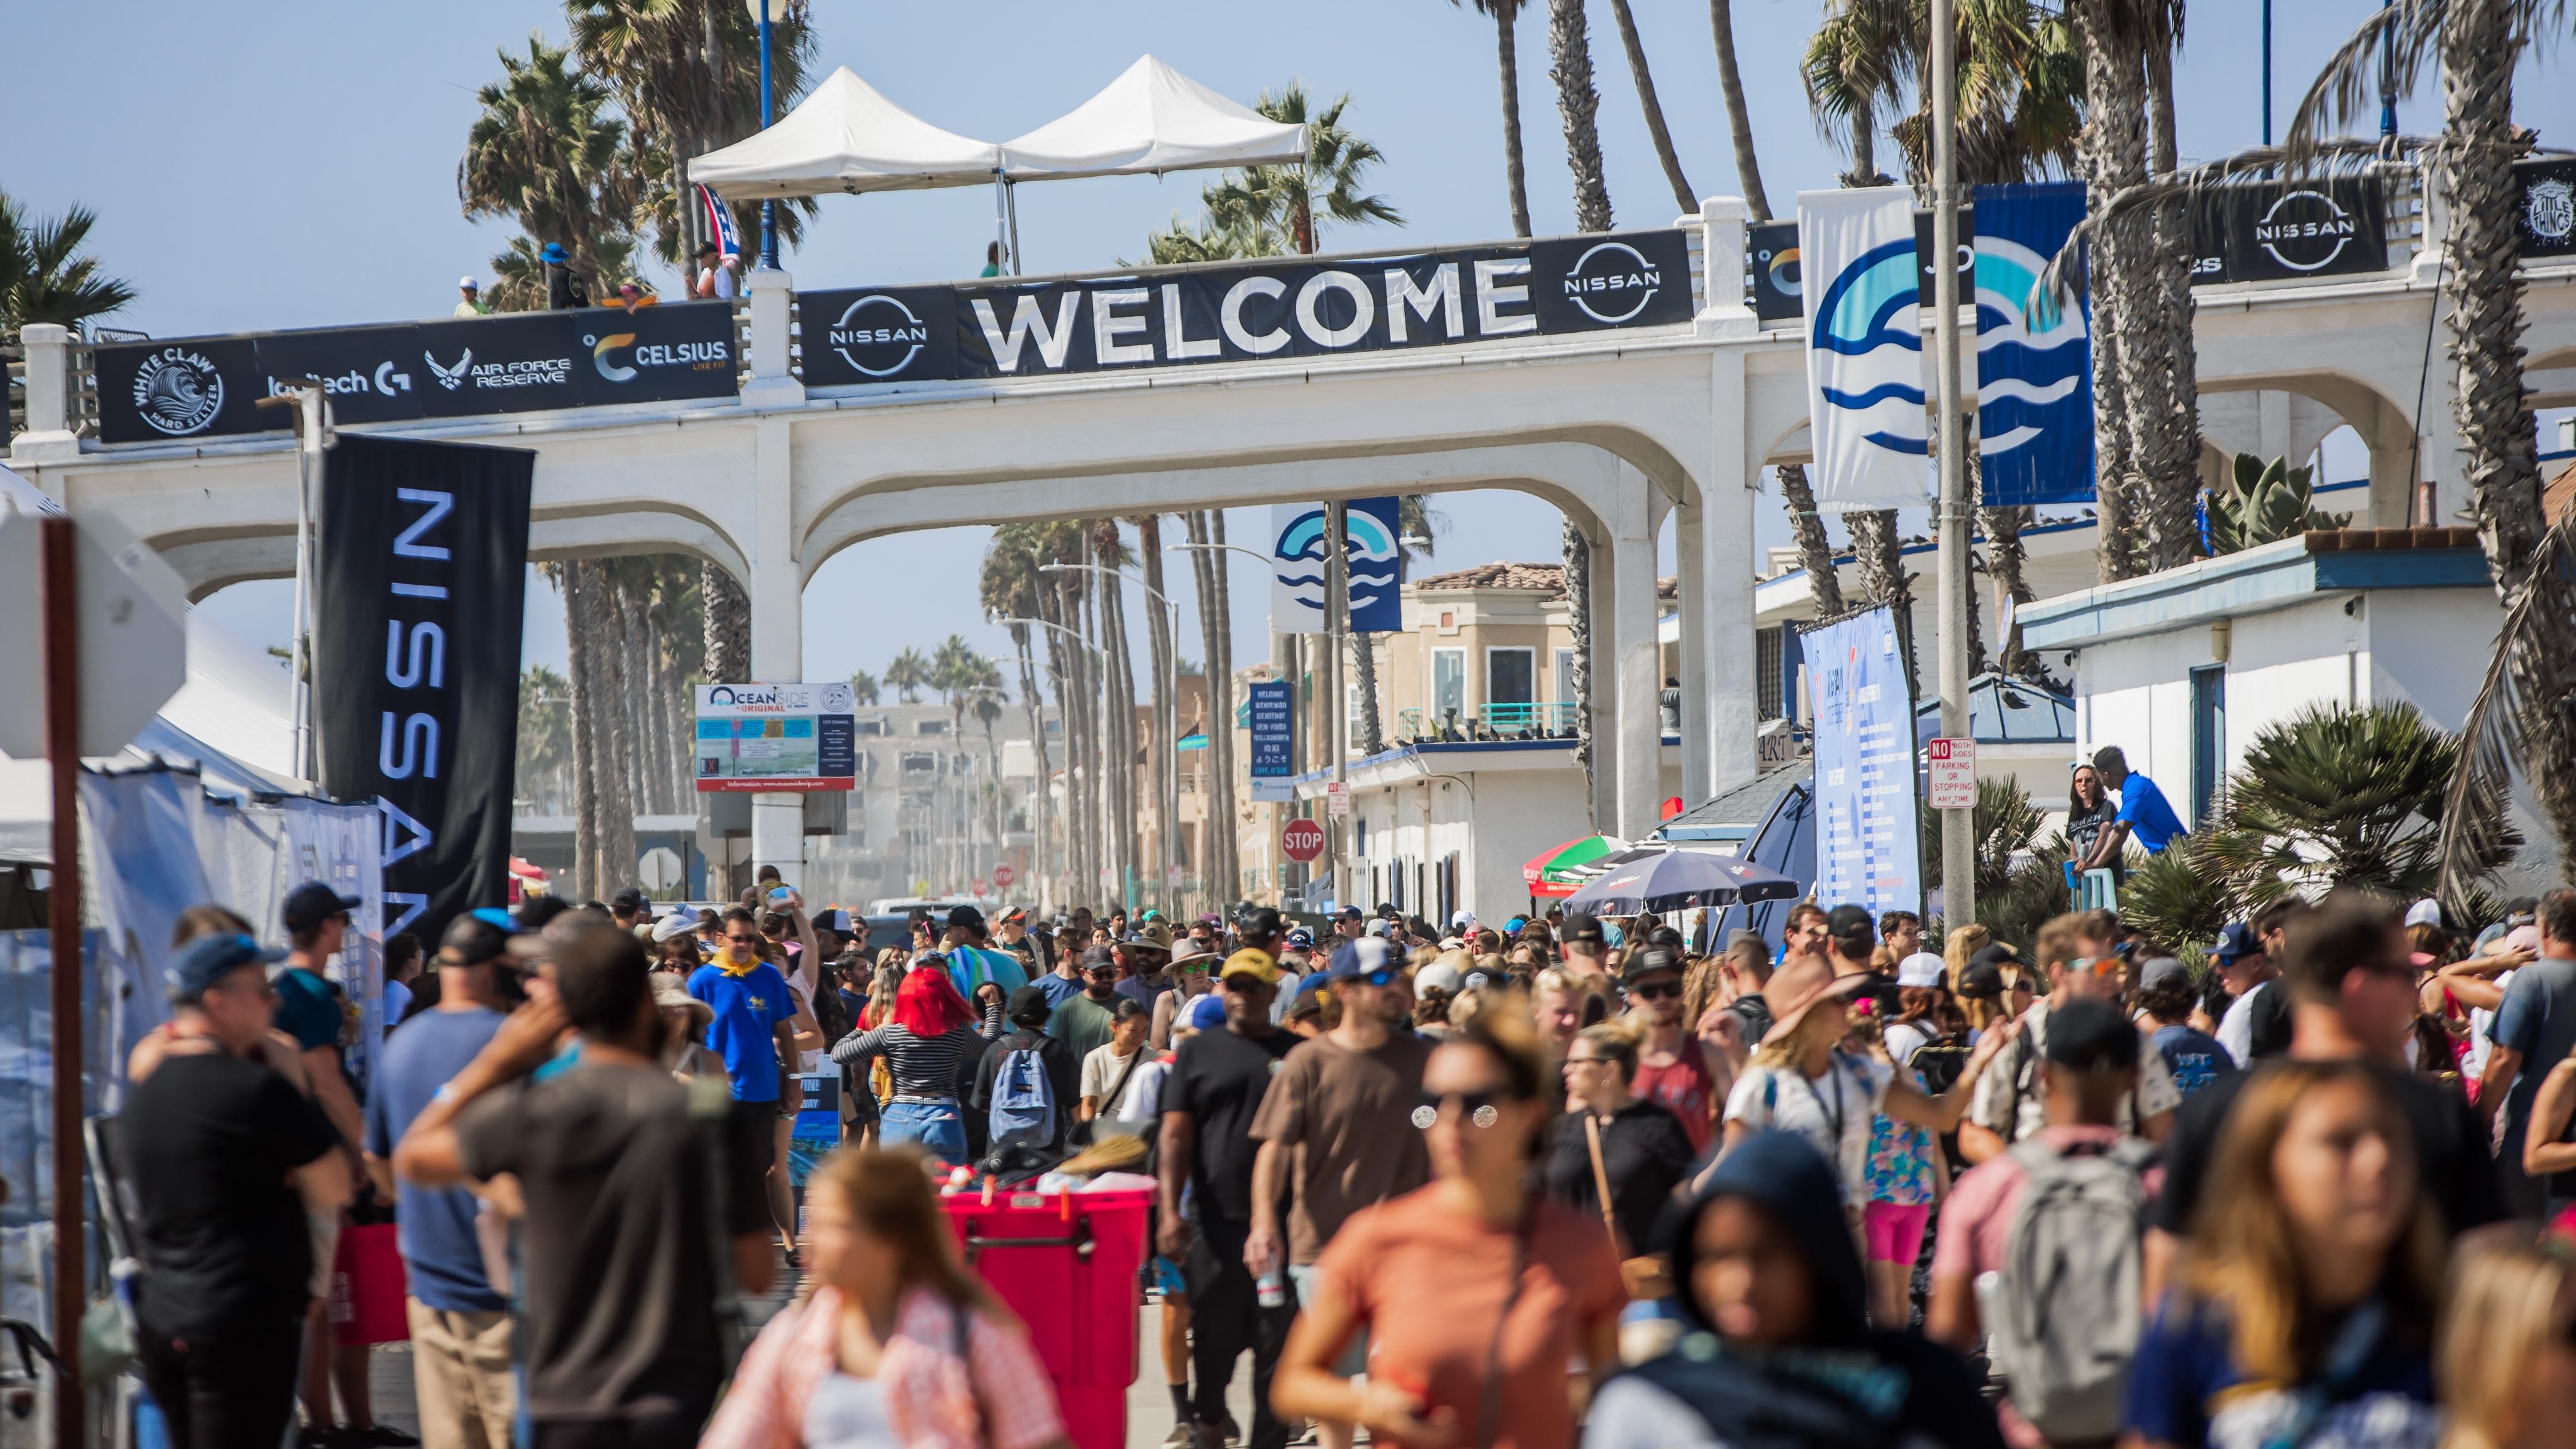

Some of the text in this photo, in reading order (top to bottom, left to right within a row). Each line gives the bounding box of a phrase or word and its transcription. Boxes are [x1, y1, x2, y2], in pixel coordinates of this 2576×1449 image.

[2533, 198, 2570, 215] LITTLE
[2257, 218, 2355, 241] NISSAN
[2533, 211, 2570, 233] THINGS
[1565, 270, 1660, 294] NISSAN
[971, 257, 1537, 372] WELCOME
[830, 327, 928, 346] NISSAN
[636, 341, 728, 367] CELSIUS
[470, 358, 572, 377] AIR FORCE
[692, 361, 727, 370] LIVE FIT
[133, 348, 217, 407] WHITE CLAW
[268, 370, 369, 397] loech
[476, 370, 567, 388] RESERVE
[151, 384, 218, 429] HARD SELTZER
[1256, 755, 1287, 763] ようこそ
[1932, 742, 1948, 757] NO
[1329, 784, 1338, 792] NO
[1935, 783, 1972, 791] STOPPING
[1285, 831, 1323, 850] STOP
